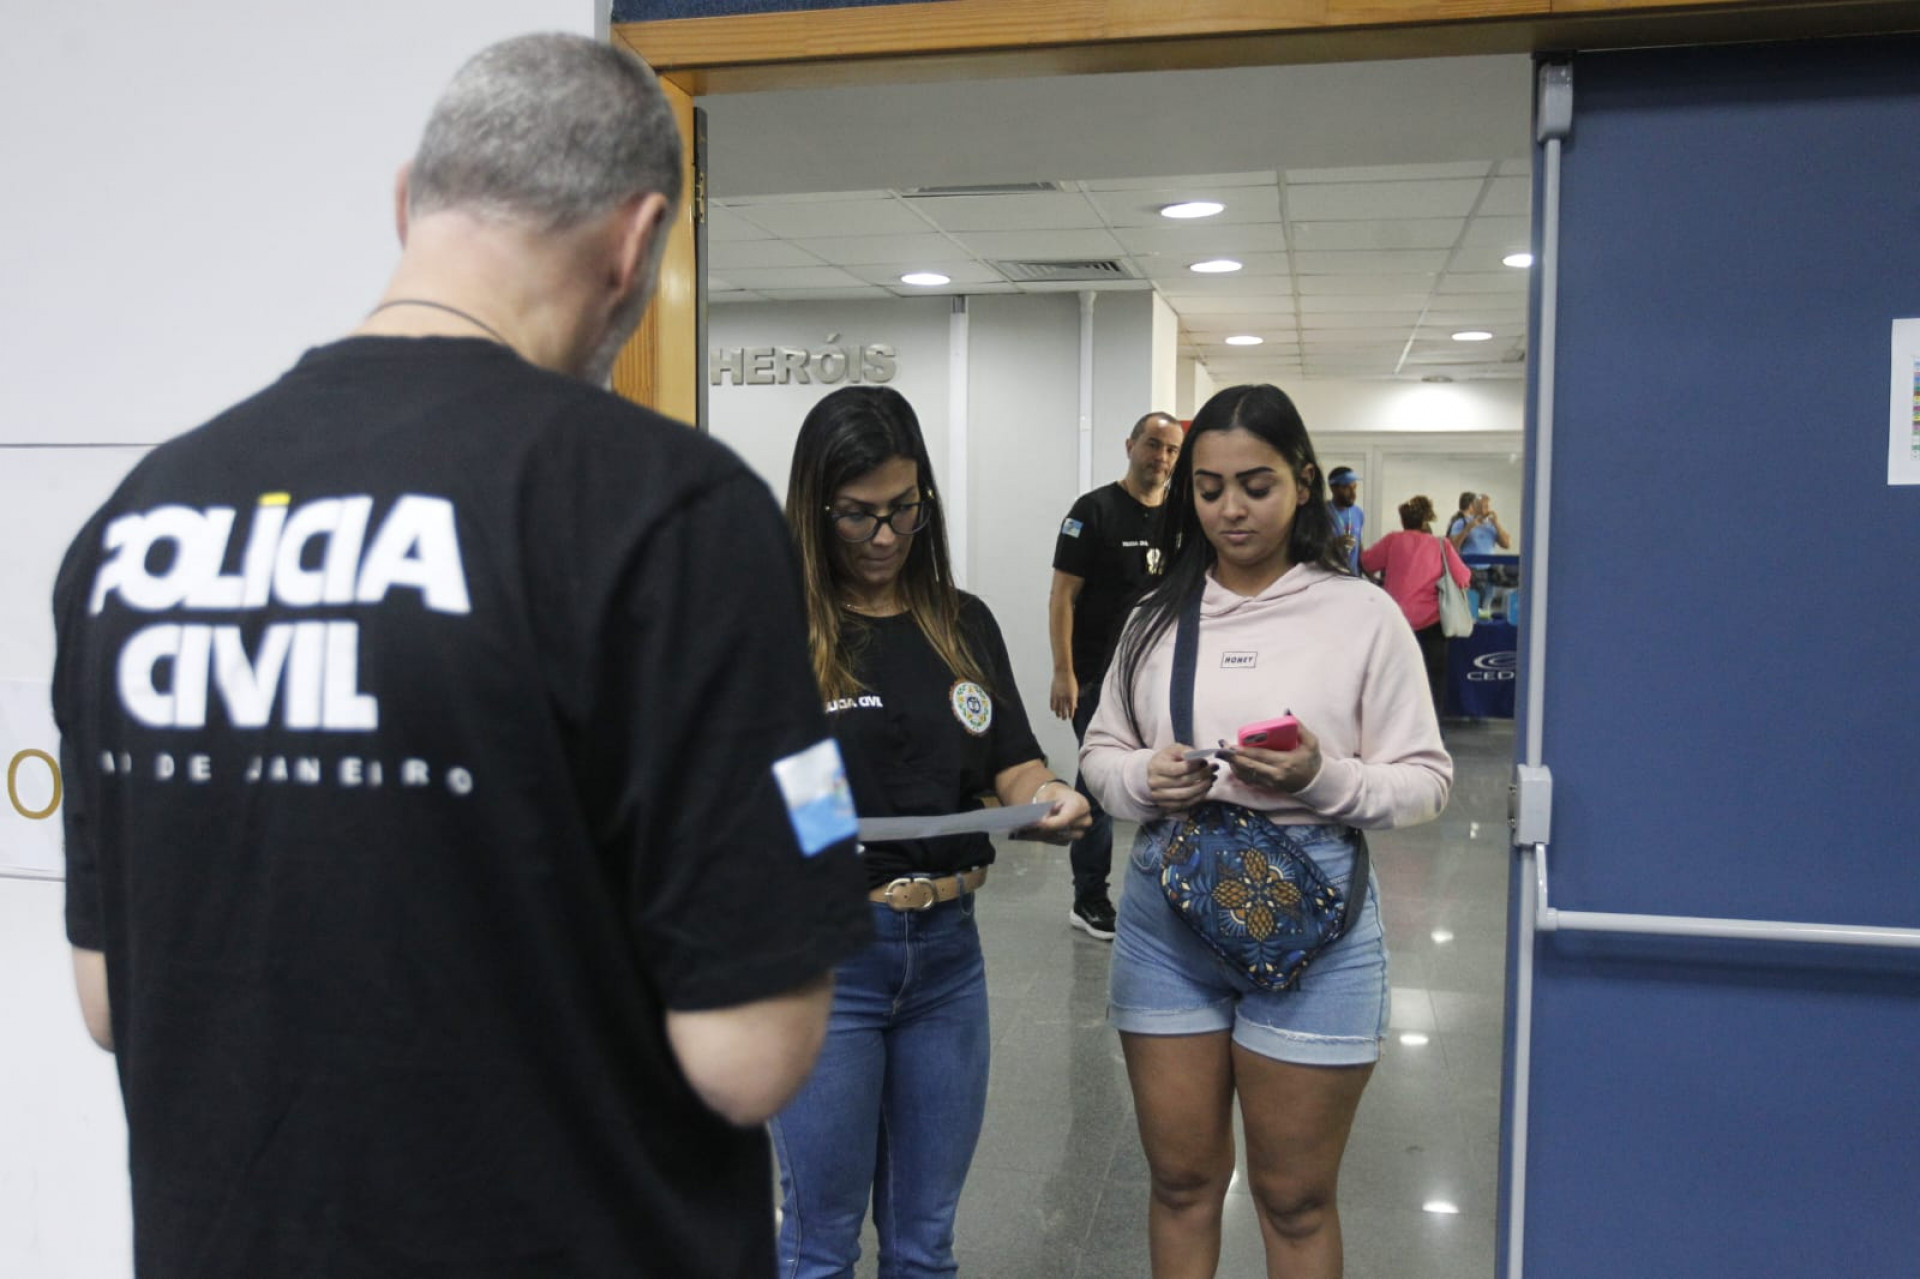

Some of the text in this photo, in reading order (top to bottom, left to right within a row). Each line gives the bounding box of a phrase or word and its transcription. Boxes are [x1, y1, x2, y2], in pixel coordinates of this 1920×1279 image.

[709, 333, 897, 386] HERÓIS
[117, 619, 379, 731] CIVIL
[1466, 671, 1515, 680] CED
[154, 752, 213, 783] DE
[245, 755, 475, 796] JANEIRO
